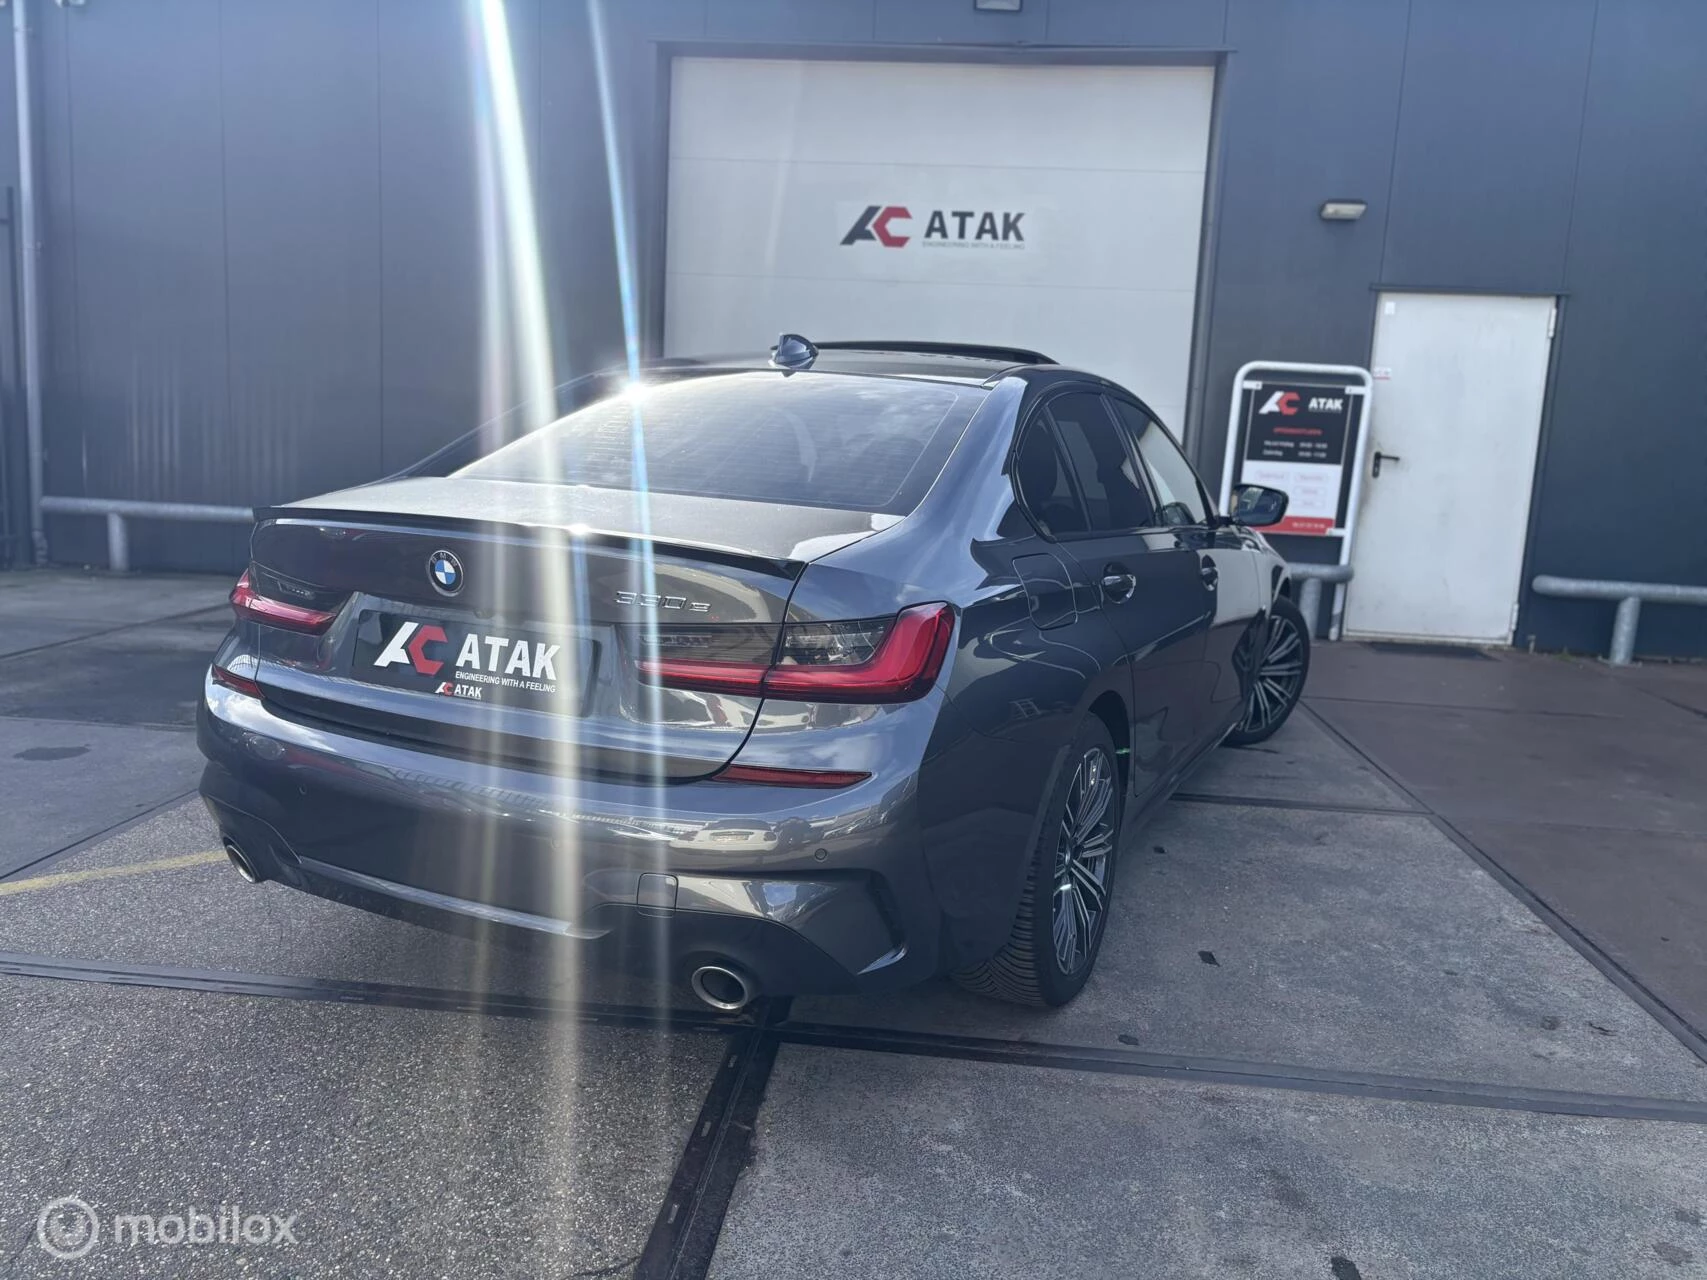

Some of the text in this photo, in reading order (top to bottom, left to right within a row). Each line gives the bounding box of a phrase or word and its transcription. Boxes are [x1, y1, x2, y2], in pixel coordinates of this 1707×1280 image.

[840, 205, 1025, 248] AC ATAK
[1308, 397, 1343, 411] ATAK
[616, 591, 711, 612] 330e
[373, 621, 560, 680] AC ATAK
[454, 684, 482, 698] ATAK
[455, 670, 556, 693] ENGINEERING WITH A FEELING
